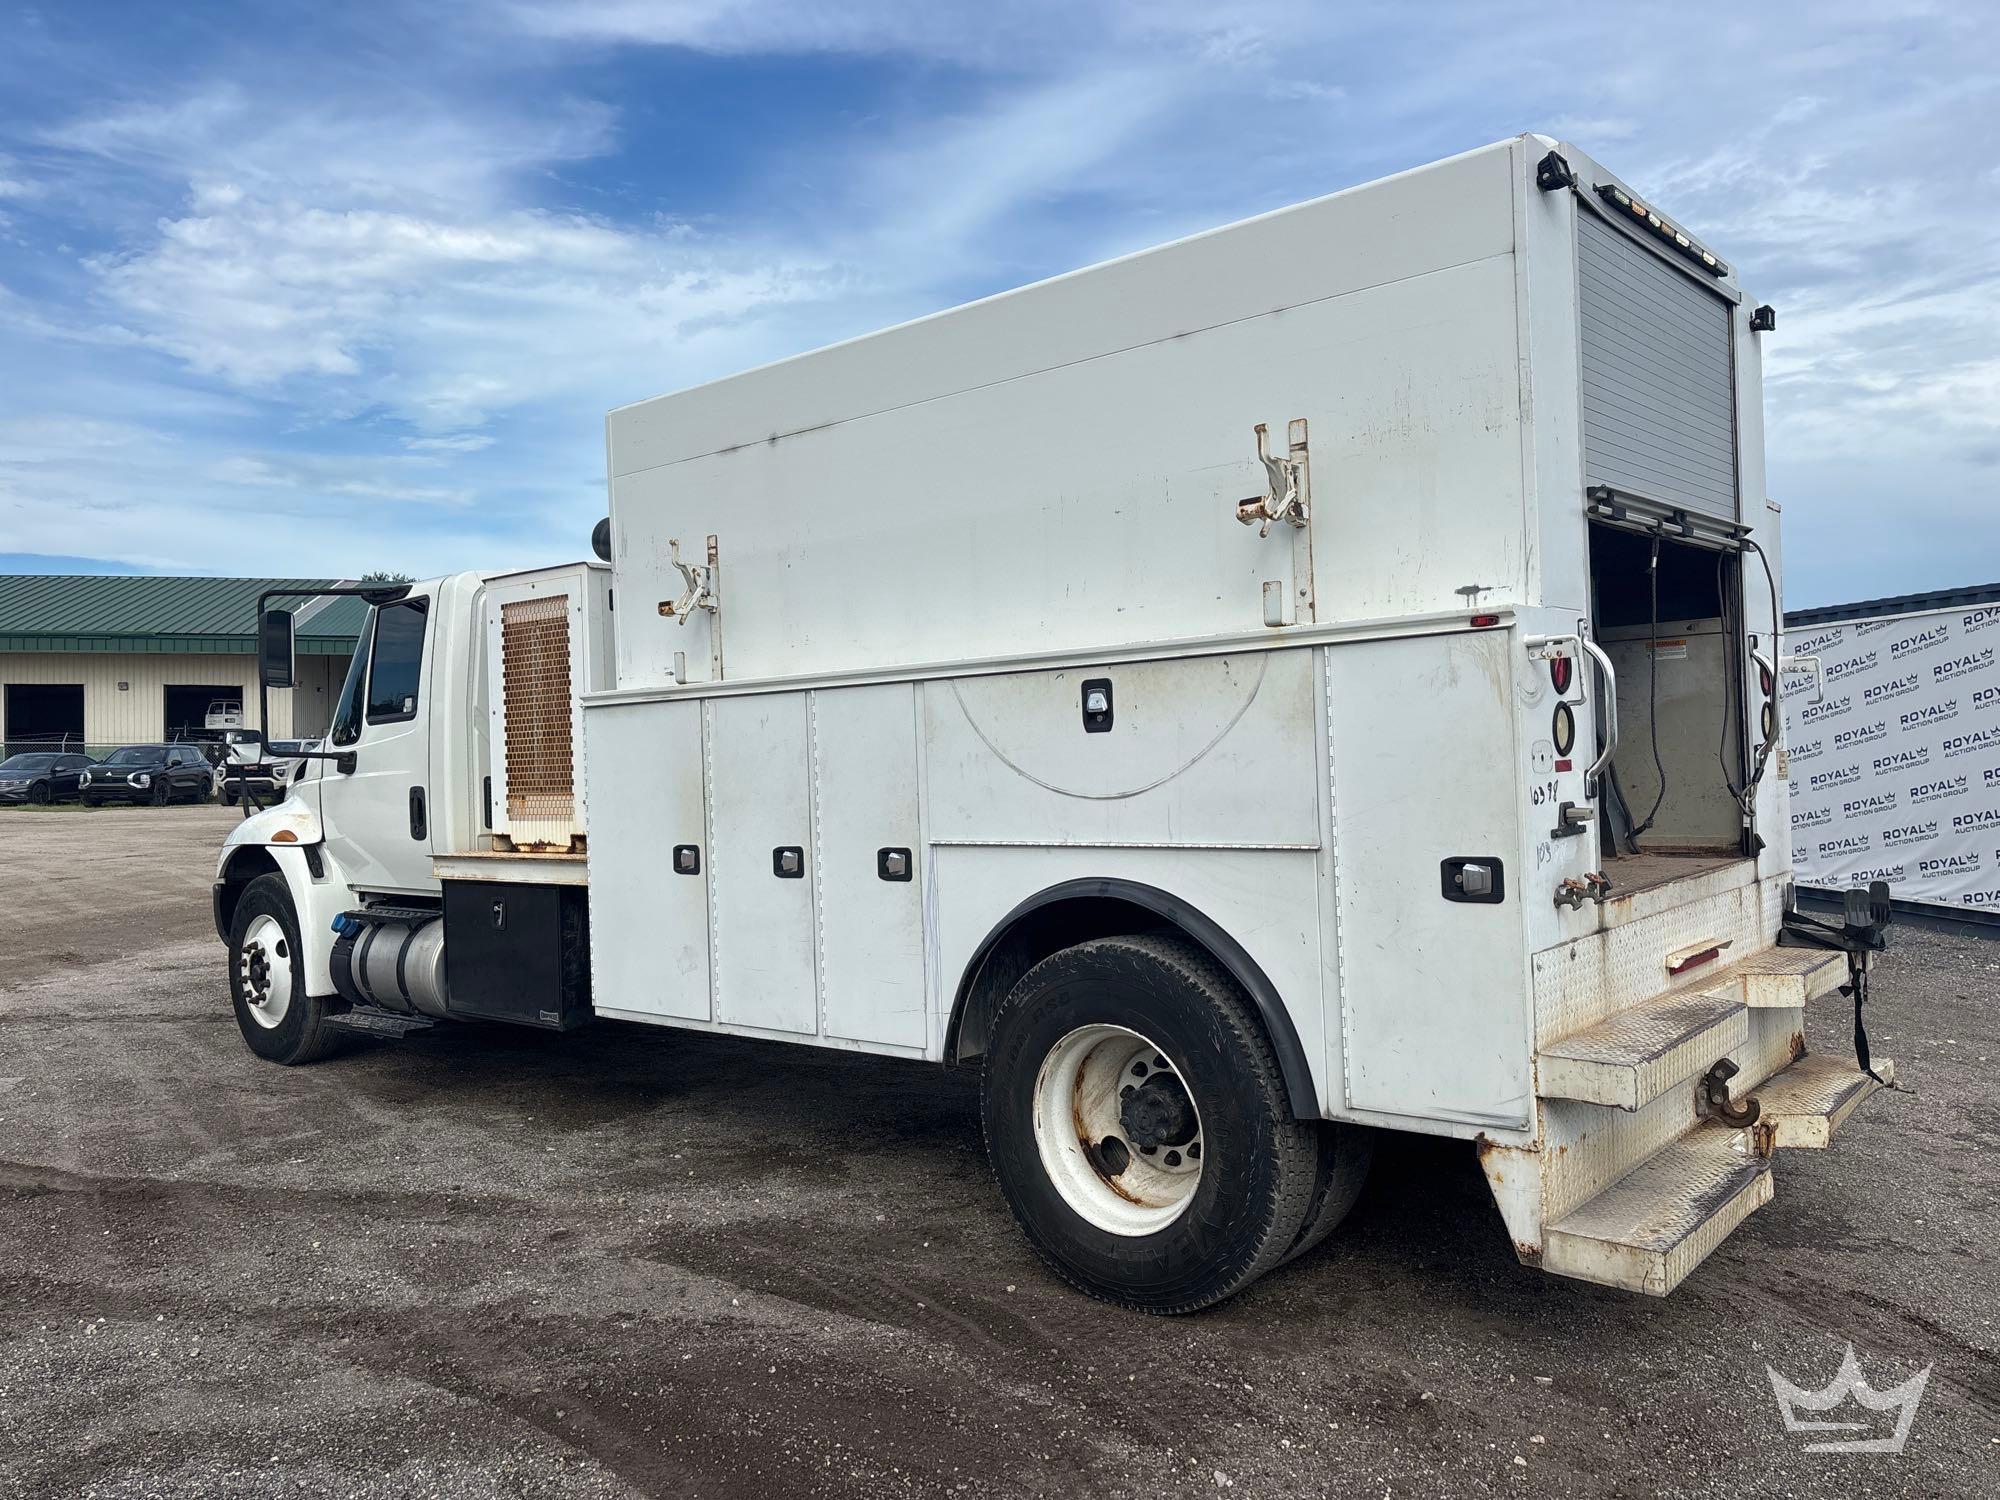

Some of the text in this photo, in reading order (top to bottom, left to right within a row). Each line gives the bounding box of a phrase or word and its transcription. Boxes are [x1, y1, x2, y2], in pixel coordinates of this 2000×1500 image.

[1857, 622, 1885, 637] AUCTION
[1964, 618, 2000, 635] AUCTION
[1794, 633, 1832, 655] ROYAL
[1822, 639, 1844, 651] GROUP
[1890, 630, 1936, 654] ROYAL
[1892, 635, 1949, 660] AUCTION GROUP
[1825, 656, 1866, 677] ROYAL
[1827, 661, 1878, 683] AUCTION GROUP
[1933, 653, 1981, 676] ROYAL
[1935, 659, 1995, 684] AUCTION GROUP
[1784, 678, 1804, 691] YAL
[1863, 678, 1907, 699] ROYAL
[1865, 684, 1920, 706] AUCTION GROUP
[1802, 700, 1841, 720] ROYAL
[1803, 706, 1852, 726] AUCTION GROUP
[1900, 704, 1946, 725] ROYAL
[1901, 710, 1959, 732] AUCTION GROUP
[1834, 725, 1875, 744] ROYAL
[1835, 731, 1887, 751] AUCTION GROUP
[1943, 730, 1991, 751] ROYAL
[1787, 744, 1813, 758] YAL
[1944, 738, 2000, 758] AUCTION GROU
[1788, 750, 1823, 764] TION GROUP
[1873, 750, 1917, 769] ROYAL
[1875, 757, 1930, 776] AUCTION GROUP
[1810, 768, 1850, 785] ROYAL
[1812, 775, 1861, 792] AUCTION GROUP
[1910, 779, 1955, 798] ROYAL
[1912, 787, 1969, 805] AUCTION GROUP
[1843, 796, 1885, 812] ROYAL
[1845, 803, 1898, 819] AUCTION GROUP
[1791, 810, 1821, 824] OYAL
[1791, 817, 1832, 831] CTION GROUP
[1952, 809, 2000, 827] ROYAL
[1883, 824, 1926, 840] ROYAL
[1955, 823, 1989, 835] AUCTION
[1819, 837, 1859, 852] ROYAL
[1884, 832, 1939, 848] AUCTION GROUP
[1792, 856, 1808, 864] ROUP
[1820, 845, 1871, 859] AUCTION GROUP
[1919, 855, 1967, 872] ROYAL
[1921, 865, 1981, 879] AUCTION GROUP
[1851, 867, 1893, 882] ROYAL
[1852, 881, 1870, 889] AUCT
[1963, 890, 2000, 904] ROYA
